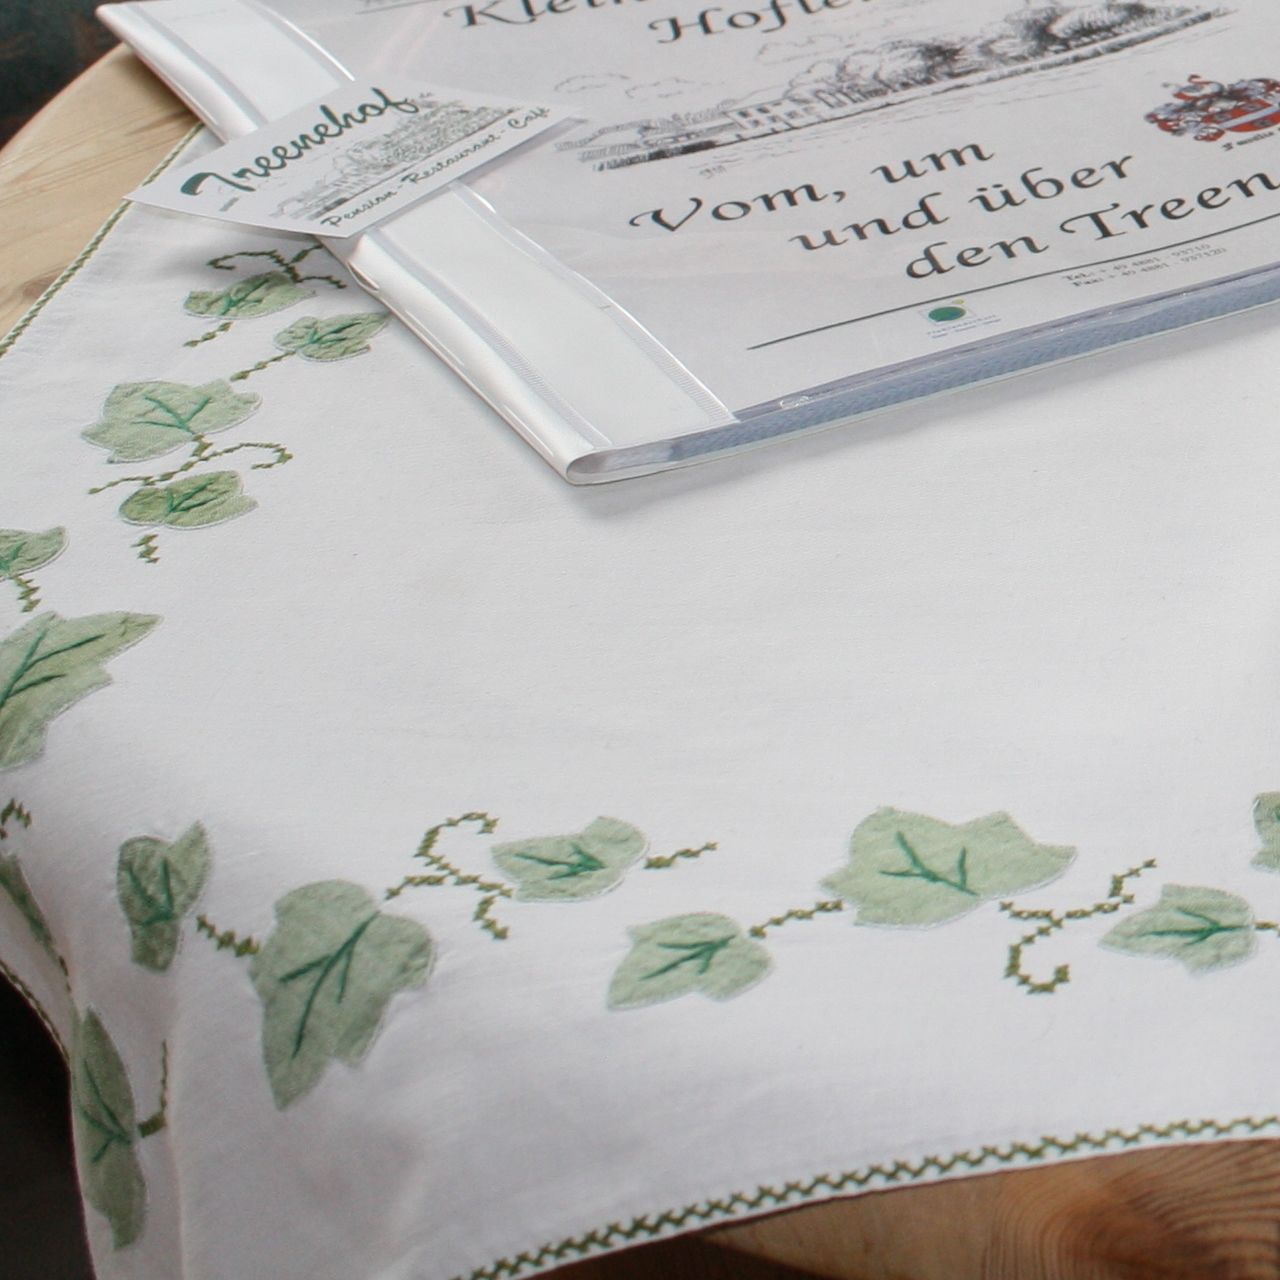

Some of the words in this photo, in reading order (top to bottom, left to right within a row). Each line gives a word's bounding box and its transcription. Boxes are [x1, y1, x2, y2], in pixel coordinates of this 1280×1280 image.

[180, 86, 420, 196] Treenehof
[320, 188, 398, 228] Pension
[629, 184, 846, 232] Vom,
[870, 143, 994, 184] um
[789, 192, 949, 250] und
[970, 155, 1133, 213] über
[905, 234, 1049, 280] den
